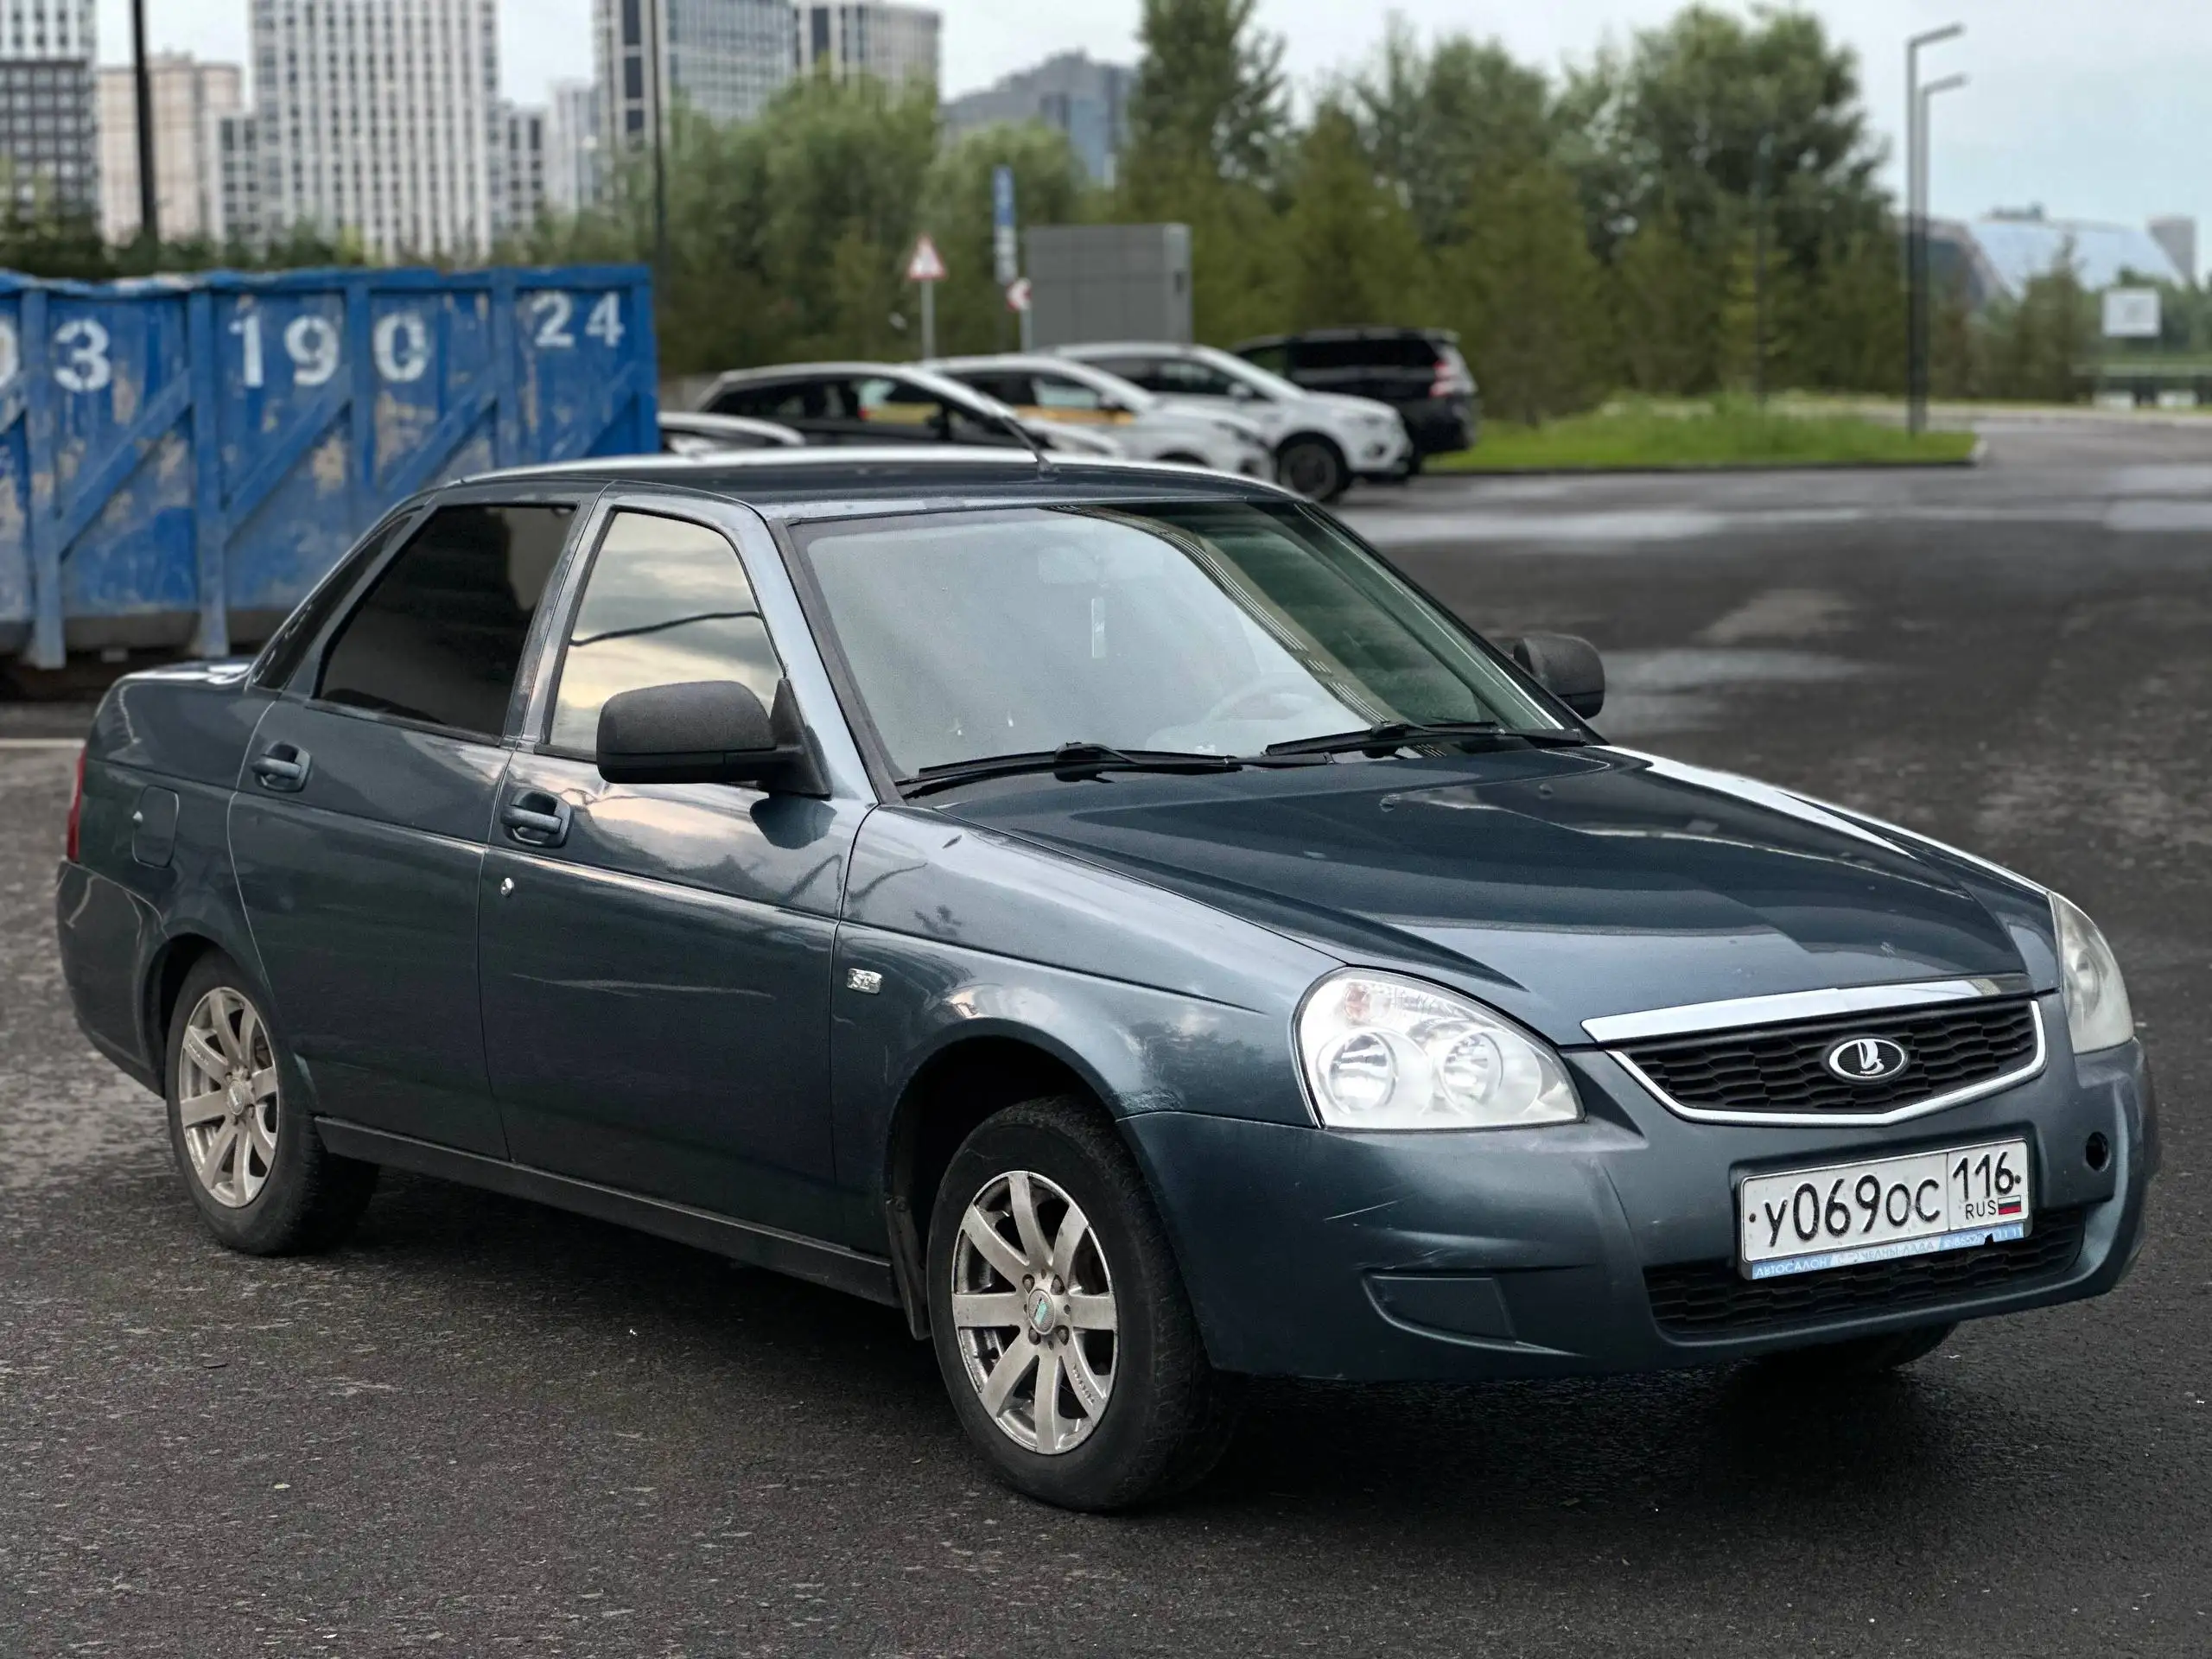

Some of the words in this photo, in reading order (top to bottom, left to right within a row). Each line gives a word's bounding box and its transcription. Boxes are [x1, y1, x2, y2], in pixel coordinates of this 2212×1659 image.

[228, 313, 433, 387] 190
[531, 290, 626, 346] 24
[1953, 1151, 2014, 1201] 116
[1966, 1199, 1997, 1220] RUS
[1755, 1258, 1827, 1278] АВТОСАЛОН
